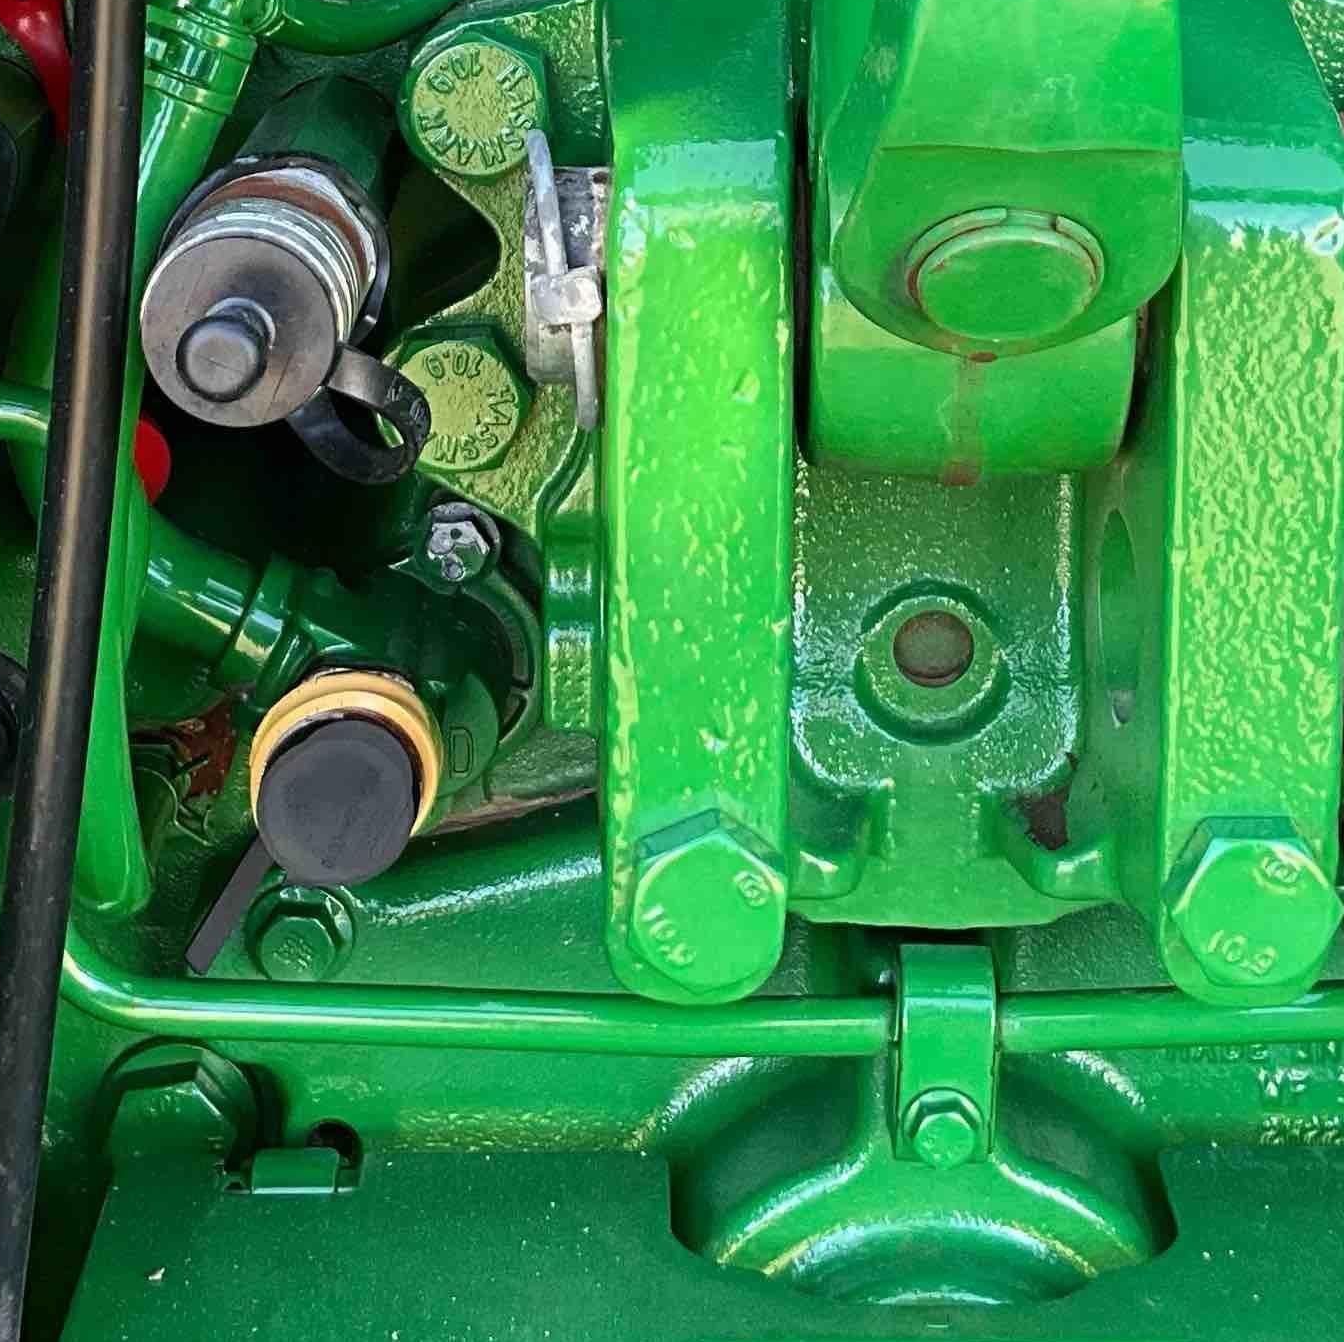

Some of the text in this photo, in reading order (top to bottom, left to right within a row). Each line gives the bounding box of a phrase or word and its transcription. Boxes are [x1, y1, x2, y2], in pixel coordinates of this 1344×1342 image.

[427, 48, 484, 94] 10.9
[424, 347, 484, 379] 10.9
[448, 726, 474, 778] D
